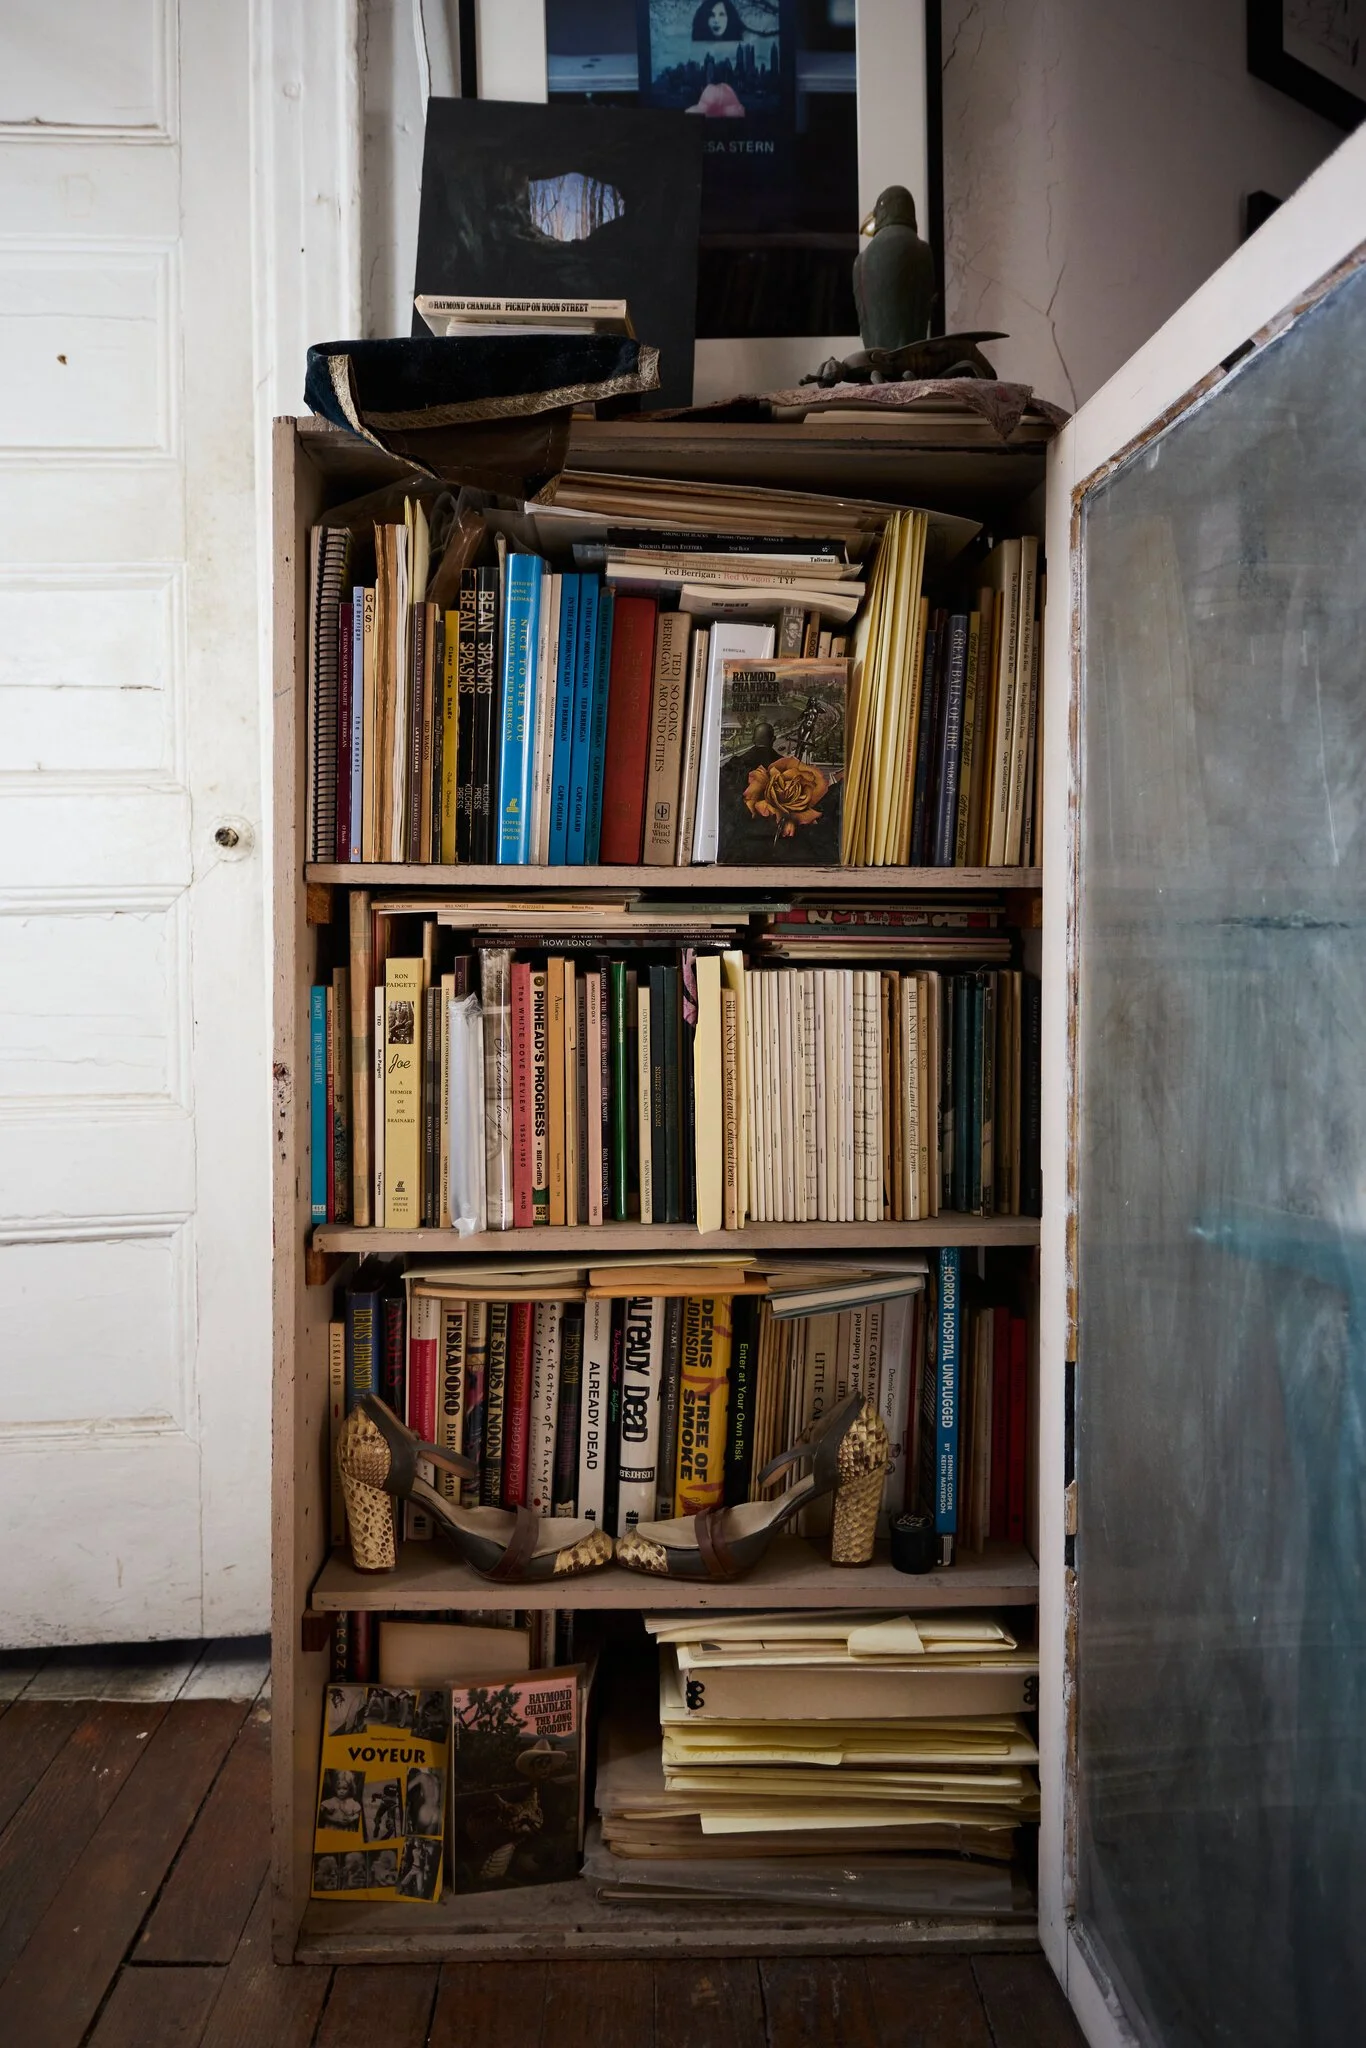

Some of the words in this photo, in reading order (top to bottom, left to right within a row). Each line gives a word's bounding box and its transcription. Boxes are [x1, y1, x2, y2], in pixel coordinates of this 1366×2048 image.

[728, 140, 775, 153] STERN
[434, 301, 465, 310] RAYMOND
[466, 301, 501, 310] CHANDLER
[505, 302, 531, 311] PICKUP
[531, 303, 542, 311] ON
[542, 303, 560, 312] NOON
[561, 303, 588, 312] STREET
[664, 567, 679, 575] Ted
[681, 569, 716, 579] Berrigan
[723, 572, 739, 580] Red
[741, 574, 771, 584] Wagon
[460, 590, 475, 632] BEAN
[478, 590, 495, 633] BEAN
[519, 619, 528, 652] NICE
[661, 618, 672, 675] BERRIGAN
[952, 629, 965, 667] GREAT
[459, 642, 475, 694] SPASMS
[477, 642, 493, 695] SPASMS
[508, 660, 515, 673] TO
[518, 658, 527, 676] TO
[564, 640, 573, 670] MORNING
[672, 652, 682, 676] TED
[507, 675, 515, 692] TED
[732, 671, 776, 681] RAYMOND
[732, 682, 780, 692] CHANDLER
[950, 670, 962, 705] BALLS
[517, 683, 525, 707] SEE
[671, 684, 679, 700] SO
[506, 696, 514, 742] BERRIGAN
[656, 684, 668, 735] AROUND
[668, 702, 679, 741] GOING
[949, 707, 960, 721] OF
[517, 715, 525, 742] YOU
[561, 709, 569, 742] BERRIGAN
[579, 710, 587, 743] BERRIGAN
[946, 725, 959, 751] FIRE
[655, 735, 665, 772] CITIES
[946, 761, 956, 794] PADGETT
[456, 787, 464, 809] PRESS
[464, 783, 472, 815] KULCHUR
[474, 787, 482, 809] PRESS
[482, 783, 490, 816] KULCHUR
[557, 785, 565, 802] CAPE
[653, 822, 670, 830] Blue
[542, 939, 564, 947] HOW
[567, 939, 592, 947] LONG
[600, 991, 607, 999] AT
[908, 991, 917, 1014] BILL
[534, 991, 545, 1062] PINHEAD'S
[725, 1000, 736, 1023] BILL
[601, 1028, 607, 1036] OF
[726, 1025, 736, 1064] KNOTT
[908, 1015, 918, 1054] KNOTT
[388, 1053, 412, 1074] Joe
[642, 1044, 648, 1053] TO
[726, 1068, 736, 1100] Selected
[534, 1066, 545, 1137] PROGRESS
[726, 1102, 737, 1120] and
[726, 1121, 737, 1159] Collected
[909, 1110, 919, 1147] Collected
[727, 1162, 736, 1187] Poems
[910, 1147, 918, 1174] Poems
[942, 1266, 955, 1310] HORROR
[353, 1309, 373, 1340] DENIS
[491, 1303, 506, 1337] THE
[516, 1307, 527, 1340] DENIS
[685, 1296, 700, 1367] JOHNSON
[700, 1298, 714, 1368] DENIS
[870, 1313, 879, 1342] LITTLE
[386, 1307, 403, 1387] ANGELS
[853, 1313, 862, 1360] Underrated
[942, 1312, 955, 1361] HOSPITAL
[332, 1333, 341, 1386] FISKADORO
[352, 1343, 372, 1389] JOHNSON
[444, 1314, 463, 1416] FISKADORO
[490, 1340, 505, 1389] STARS
[739, 1343, 749, 1369] Enter
[868, 1344, 878, 1379] CAESAR
[513, 1345, 525, 1403] JOHNSON
[533, 1343, 546, 1400] johnson
[563, 1365, 580, 1384] SON
[738, 1372, 747, 1383] at
[814, 1352, 826, 1393] LITTLE
[888, 1368, 896, 1392] Dennis
[488, 1391, 503, 1409] AT
[588, 1361, 600, 1427] ALREADY
[737, 1386, 747, 1410] Your
[886, 1393, 894, 1417] Cooper
[941, 1363, 954, 1429] UNPLUGGED
[511, 1407, 522, 1459] NOBODY
[543, 1415, 554, 1431] of
[680, 1389, 696, 1481] SMOKE
[695, 1392, 711, 1448] TREE
[735, 1412, 746, 1437] Own
[487, 1413, 502, 1459] NOON
[545, 1436, 551, 1444] a
[586, 1431, 598, 1470] DEAD
[734, 1440, 744, 1461] Risk
[943, 1442, 951, 1452] BY
[508, 1463, 520, 1496] MOVE
[695, 1453, 708, 1483] OF
[946, 1454, 954, 1481] DENNIS
[524, 1701, 572, 1716] CHANDLER
[528, 1689, 572, 1705] RAYMOND
[534, 1715, 555, 1727] THE
[555, 1712, 572, 1723] LONG
[536, 1722, 573, 1736] GOODBYE
[348, 1747, 426, 1764] VOYEUR
